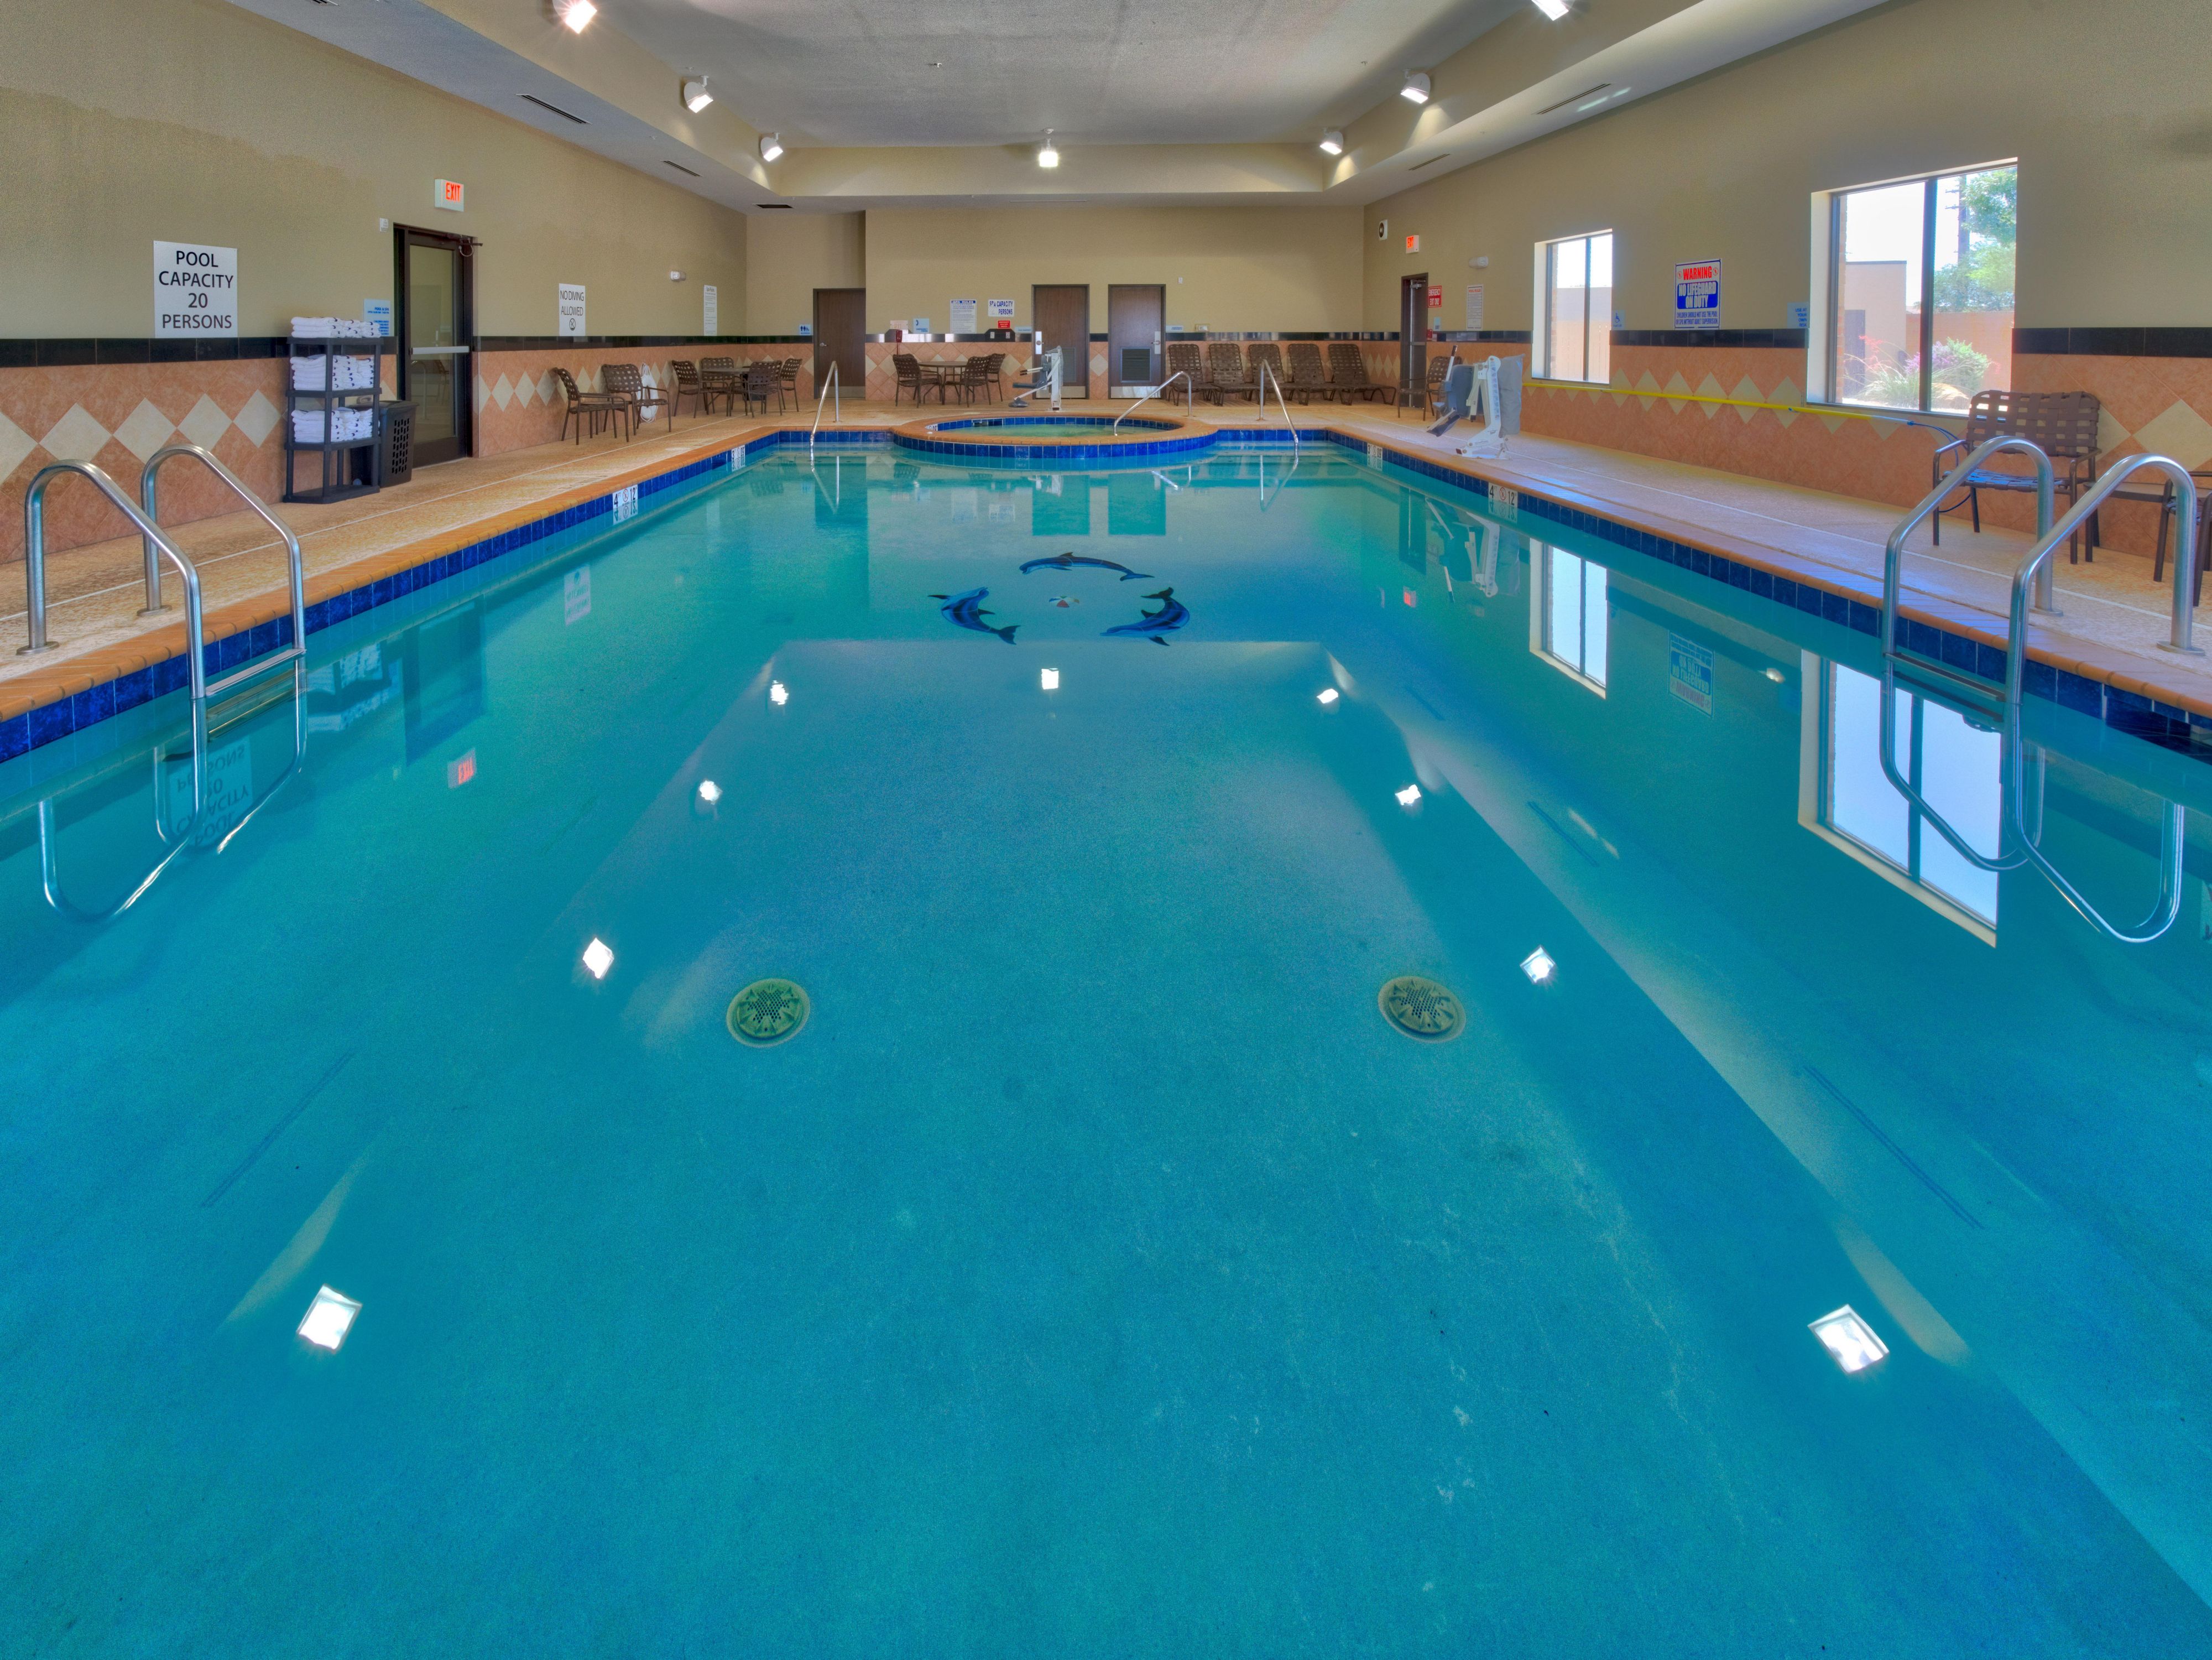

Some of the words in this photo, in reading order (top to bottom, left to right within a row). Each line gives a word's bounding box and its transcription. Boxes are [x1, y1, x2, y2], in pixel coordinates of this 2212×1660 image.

[446, 182, 461, 202] EXIT
[176, 251, 218, 268] POOL
[159, 270, 234, 288] CAPACITY
[1683, 266, 1712, 280] WARNING
[560, 290, 567, 300] NO
[568, 291, 584, 301] DIVING
[1678, 284, 1687, 296] NO
[1687, 282, 1717, 296] LIFEGUARD
[188, 293, 208, 308] 20
[1685, 295, 1693, 308] ON
[1693, 295, 1709, 308] DUTY
[561, 306, 583, 316] ALLOWED
[162, 314, 232, 329] PERSONS
[732, 450, 734, 460] 3
[1368, 444, 1370, 454] 3
[630, 487, 635, 501] 12
[1489, 485, 1494, 499] 4
[1508, 491, 1515, 506] 12
[614, 493, 618, 507] 4
